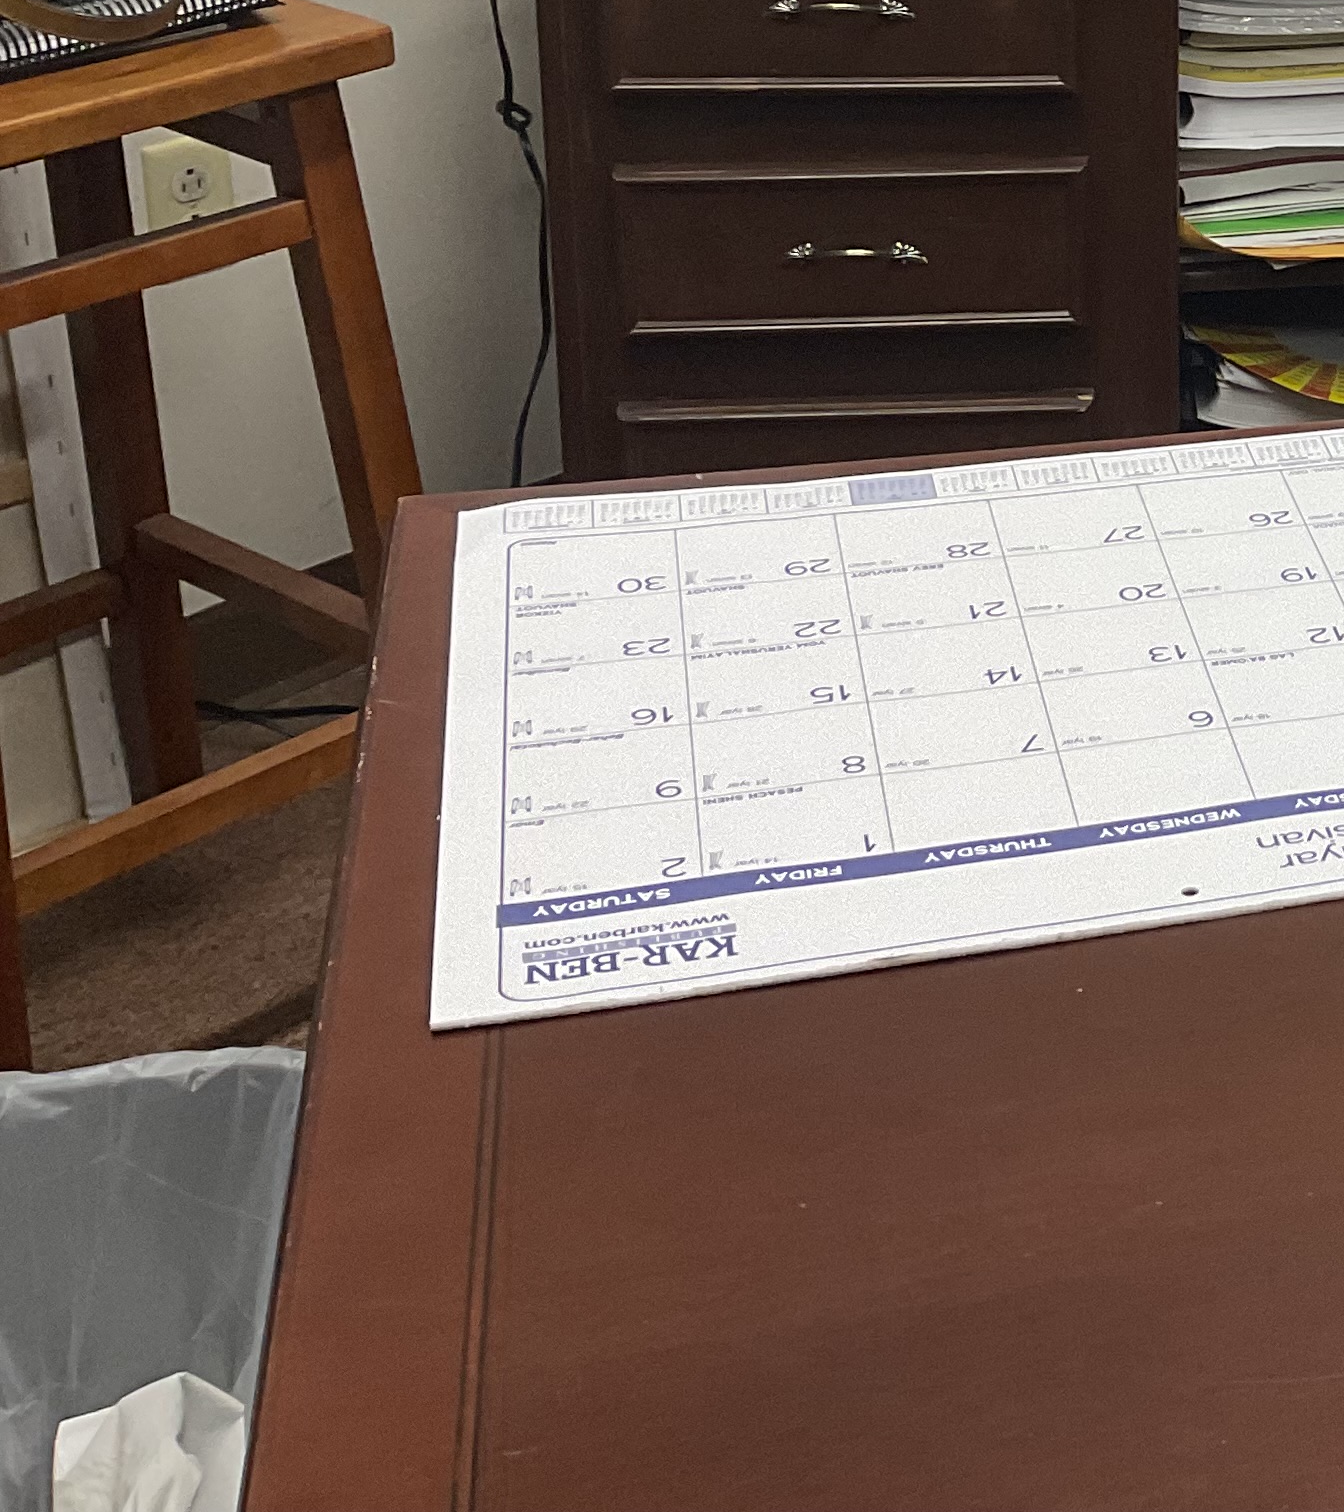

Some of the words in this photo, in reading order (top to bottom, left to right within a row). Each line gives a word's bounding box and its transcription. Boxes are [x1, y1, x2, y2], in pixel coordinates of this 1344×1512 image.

[1249, 510, 1293, 526] 26
[1103, 525, 1145, 544] 27
[946, 541, 991, 558] 28
[784, 558, 831, 575] 29
[1280, 566, 1317, 582] 19
[617, 575, 667, 593] 30
[1118, 583, 1167, 602] 20
[969, 600, 1006, 620] 21
[794, 619, 842, 637] 22
[1306, 626, 1344, 644] 12
[622, 637, 670, 656] 23
[1148, 644, 1188, 662] 13
[984, 665, 1023, 685] 14
[809, 685, 851, 703] 15
[631, 706, 674, 725] 16
[1021, 733, 1044, 753] 7
[841, 755, 866, 773] 8
[1099, 808, 1241, 838] WEDNESDAY
[863, 834, 877, 852] 1
[924, 837, 1051, 864] THURSDAY
[660, 857, 687, 878] 2
[756, 865, 843, 886] FRIDAY
[532, 888, 671, 917] SATURDAY
[524, 912, 730, 949] www.karben.com
[524, 935, 738, 985] KAR-BEN
